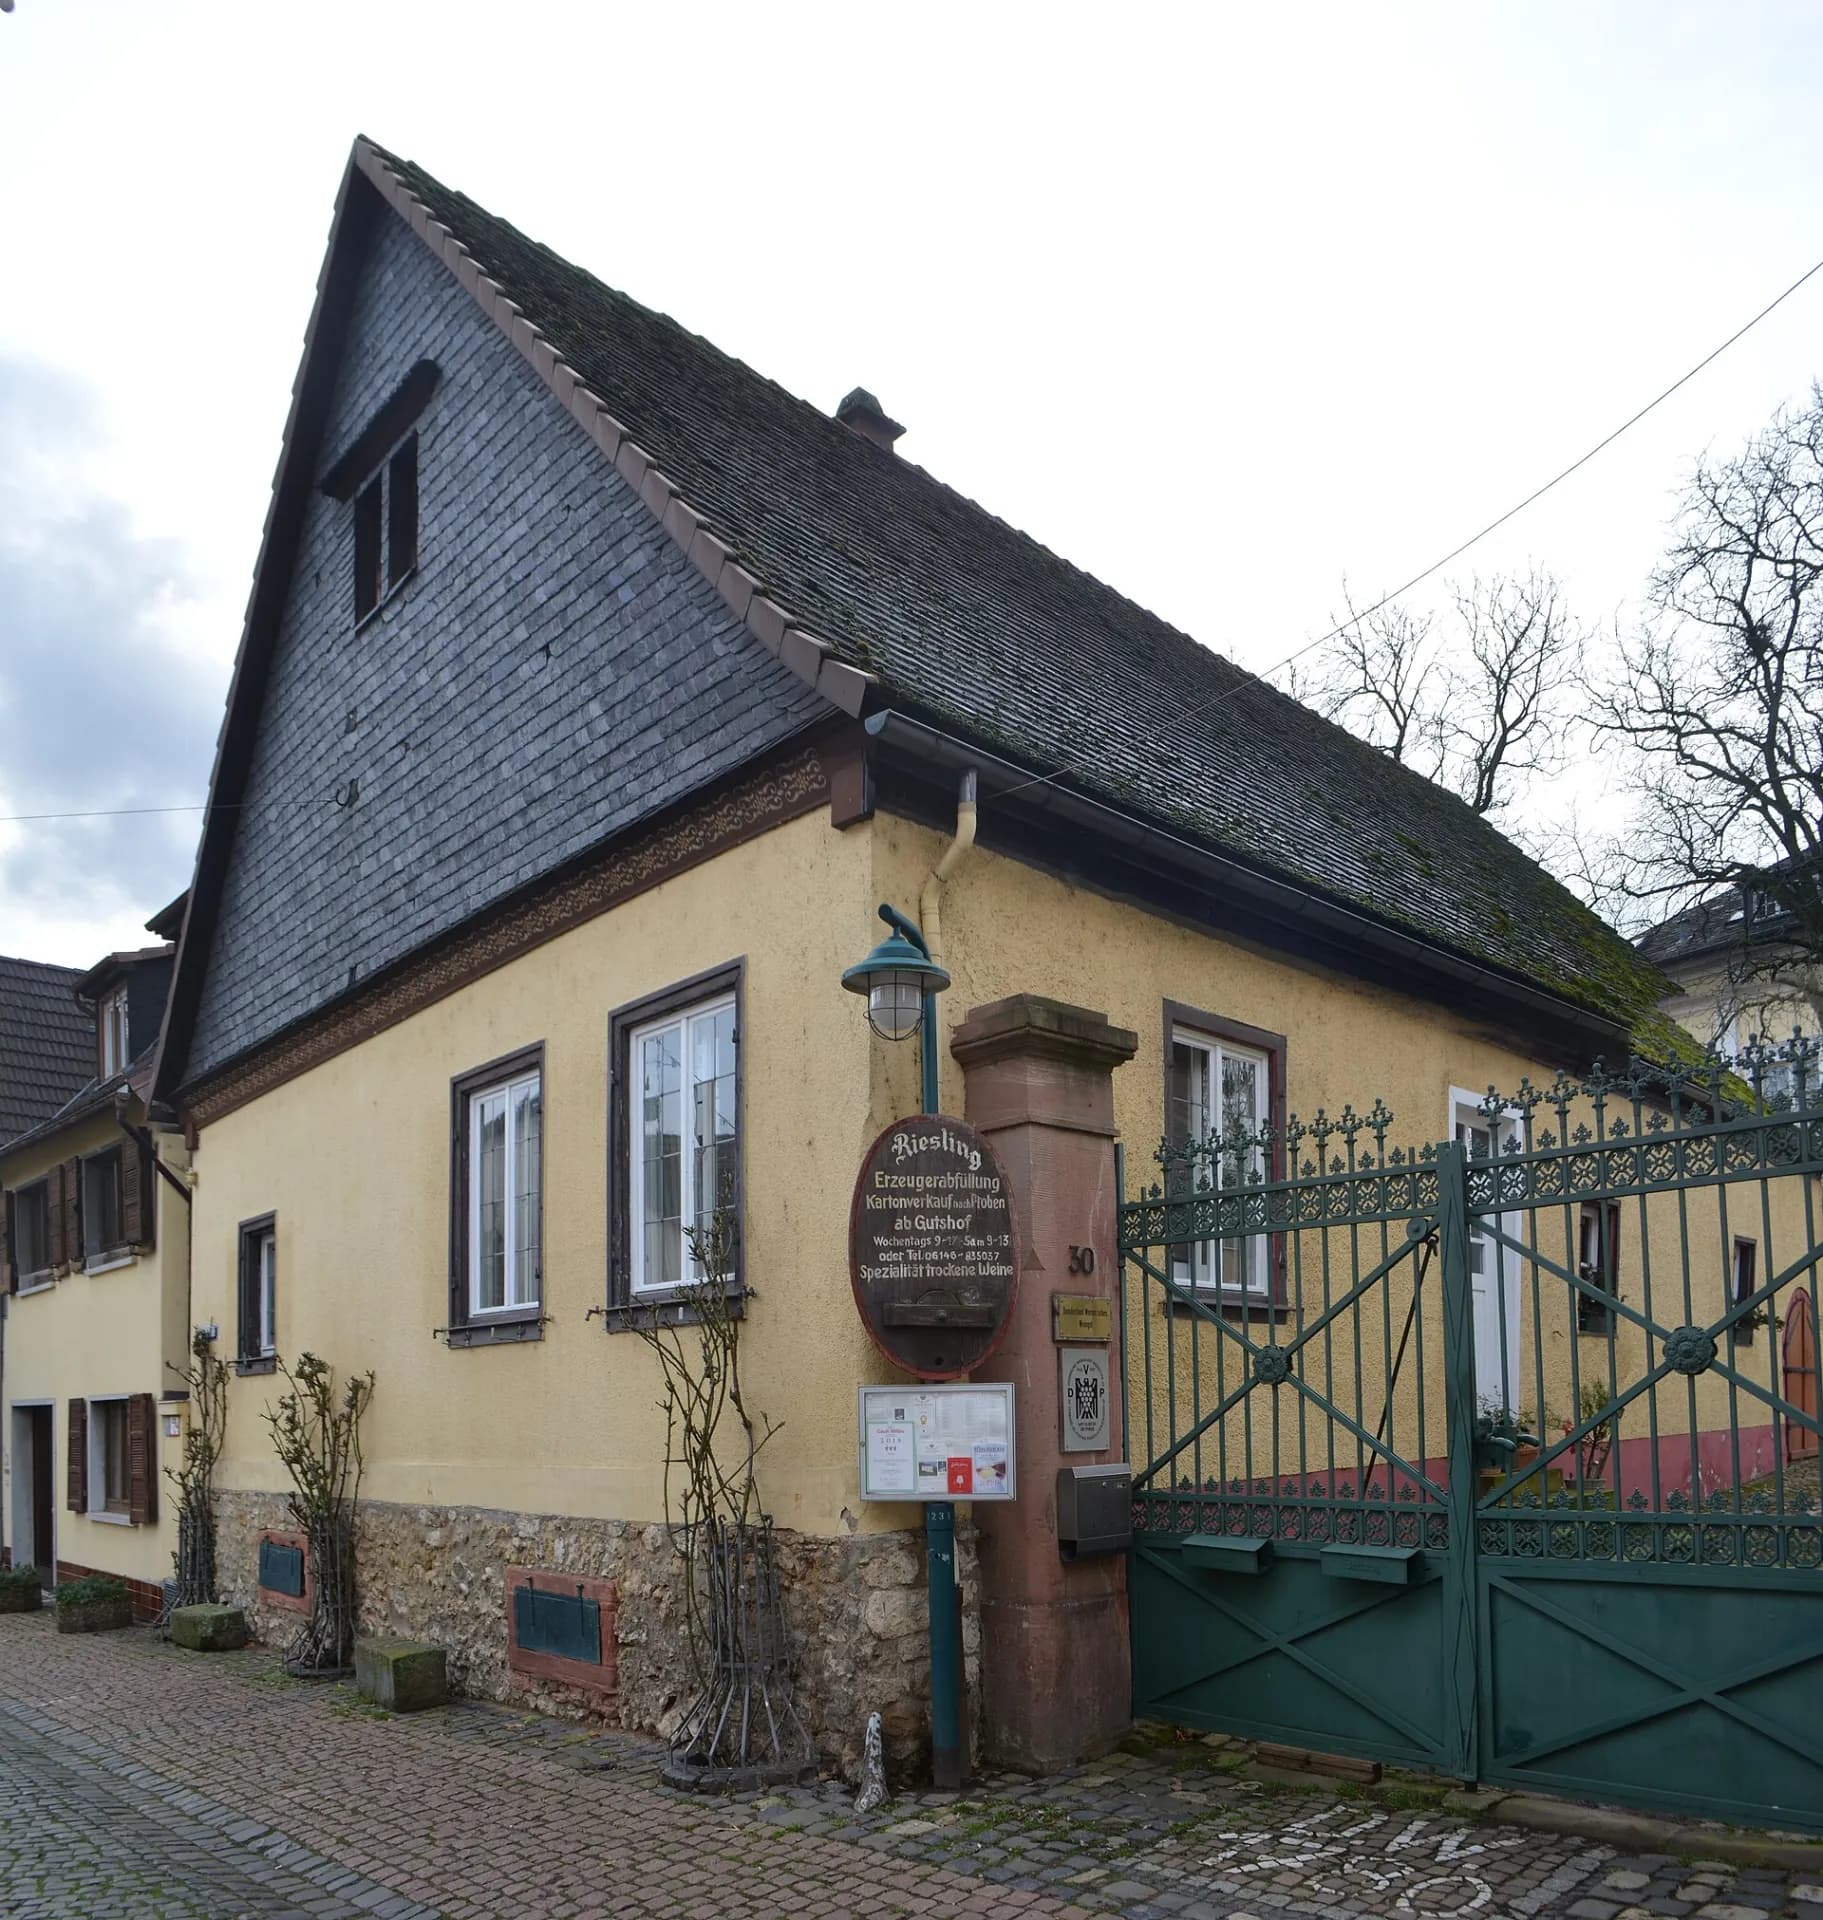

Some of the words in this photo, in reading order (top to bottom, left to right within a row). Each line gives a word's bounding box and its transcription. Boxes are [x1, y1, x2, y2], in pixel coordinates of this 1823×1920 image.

[891, 1127, 982, 1171] Riesling
[875, 1171, 1000, 1193] Erzeugerabfüllung
[866, 1193, 954, 1210] Kartonverkauf
[971, 1193, 1005, 1209] Proben
[894, 1215, 911, 1230] ab
[915, 1214, 972, 1231] Gutshof
[873, 1236, 932, 1248] Wochentags
[986, 1234, 1009, 1247] 9-13
[879, 1251, 905, 1262] oder
[1068, 1245, 1094, 1274] 30
[860, 1264, 925, 1284] Spezialität
[925, 1263, 976, 1278] trockene
[978, 1261, 1014, 1277] Weine
